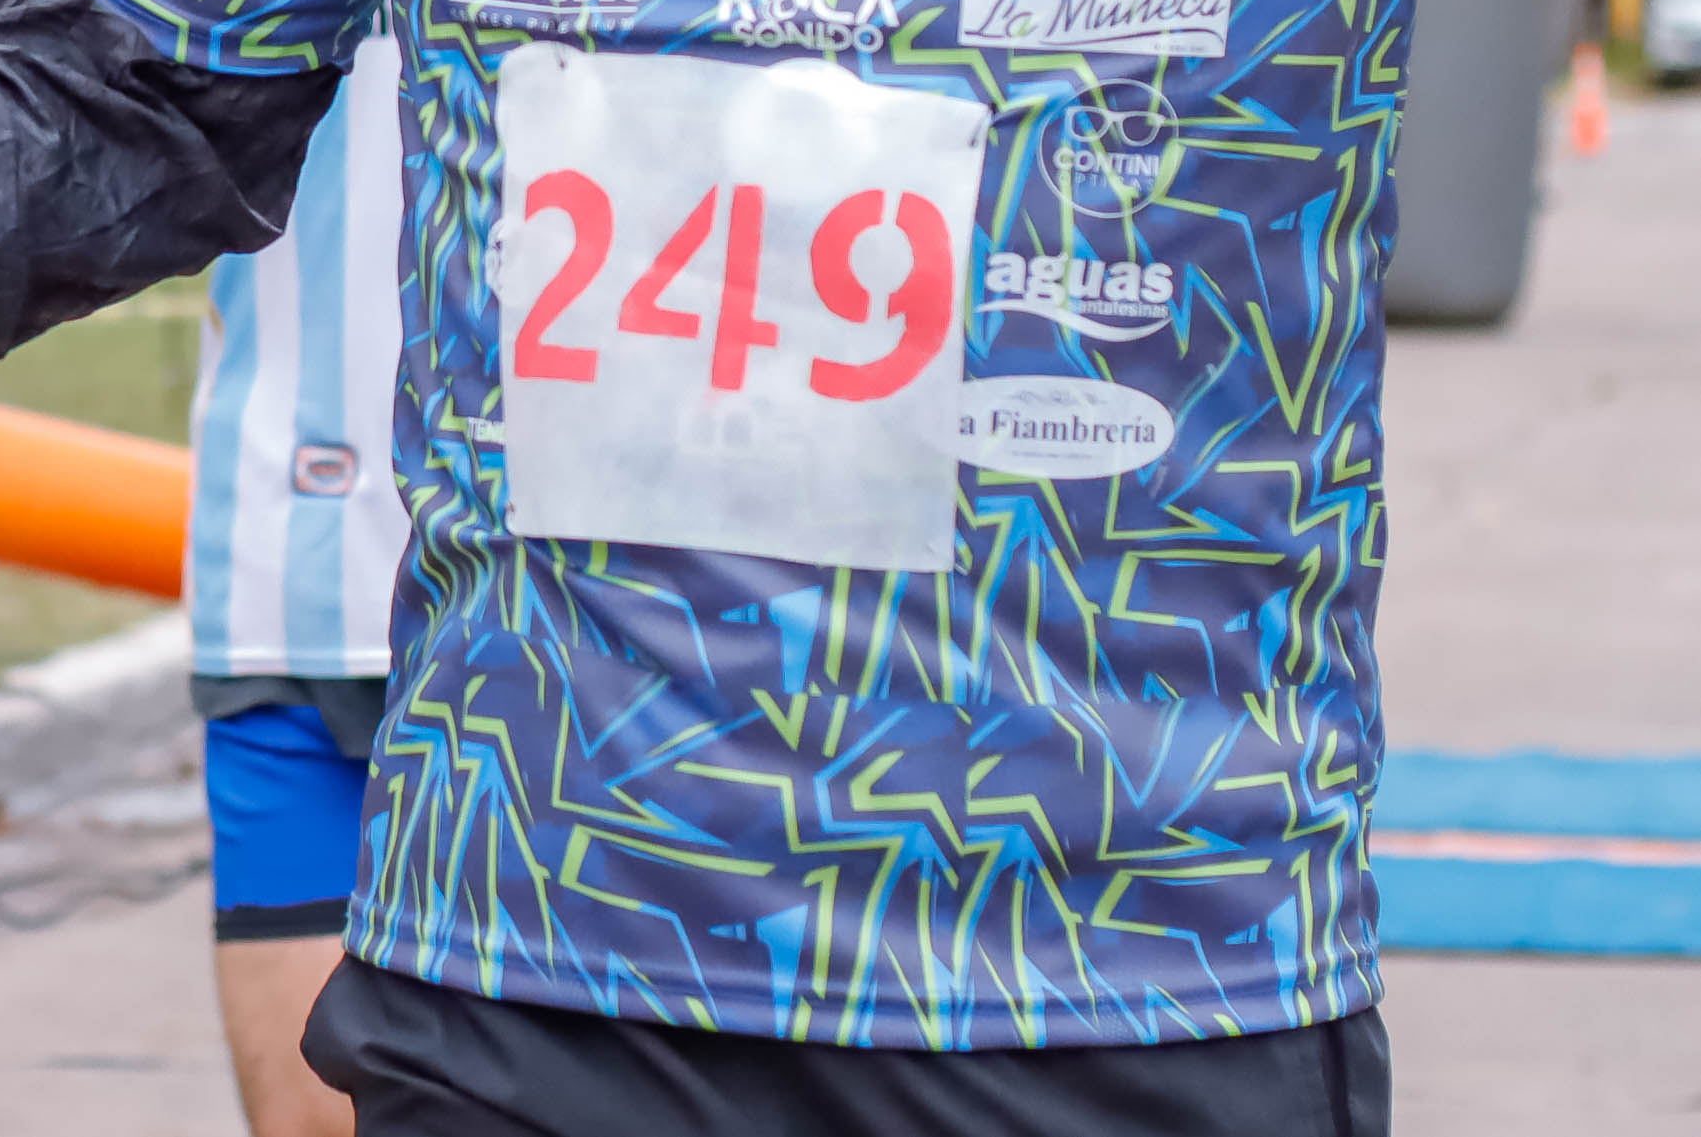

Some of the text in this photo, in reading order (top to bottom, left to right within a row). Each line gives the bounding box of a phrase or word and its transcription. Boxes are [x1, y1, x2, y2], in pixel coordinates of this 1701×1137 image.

[733, 18, 884, 54] SONIDO
[513, 169, 955, 401] 249
[986, 252, 1174, 306] aguas
[990, 409, 1157, 444] Fiambrería
